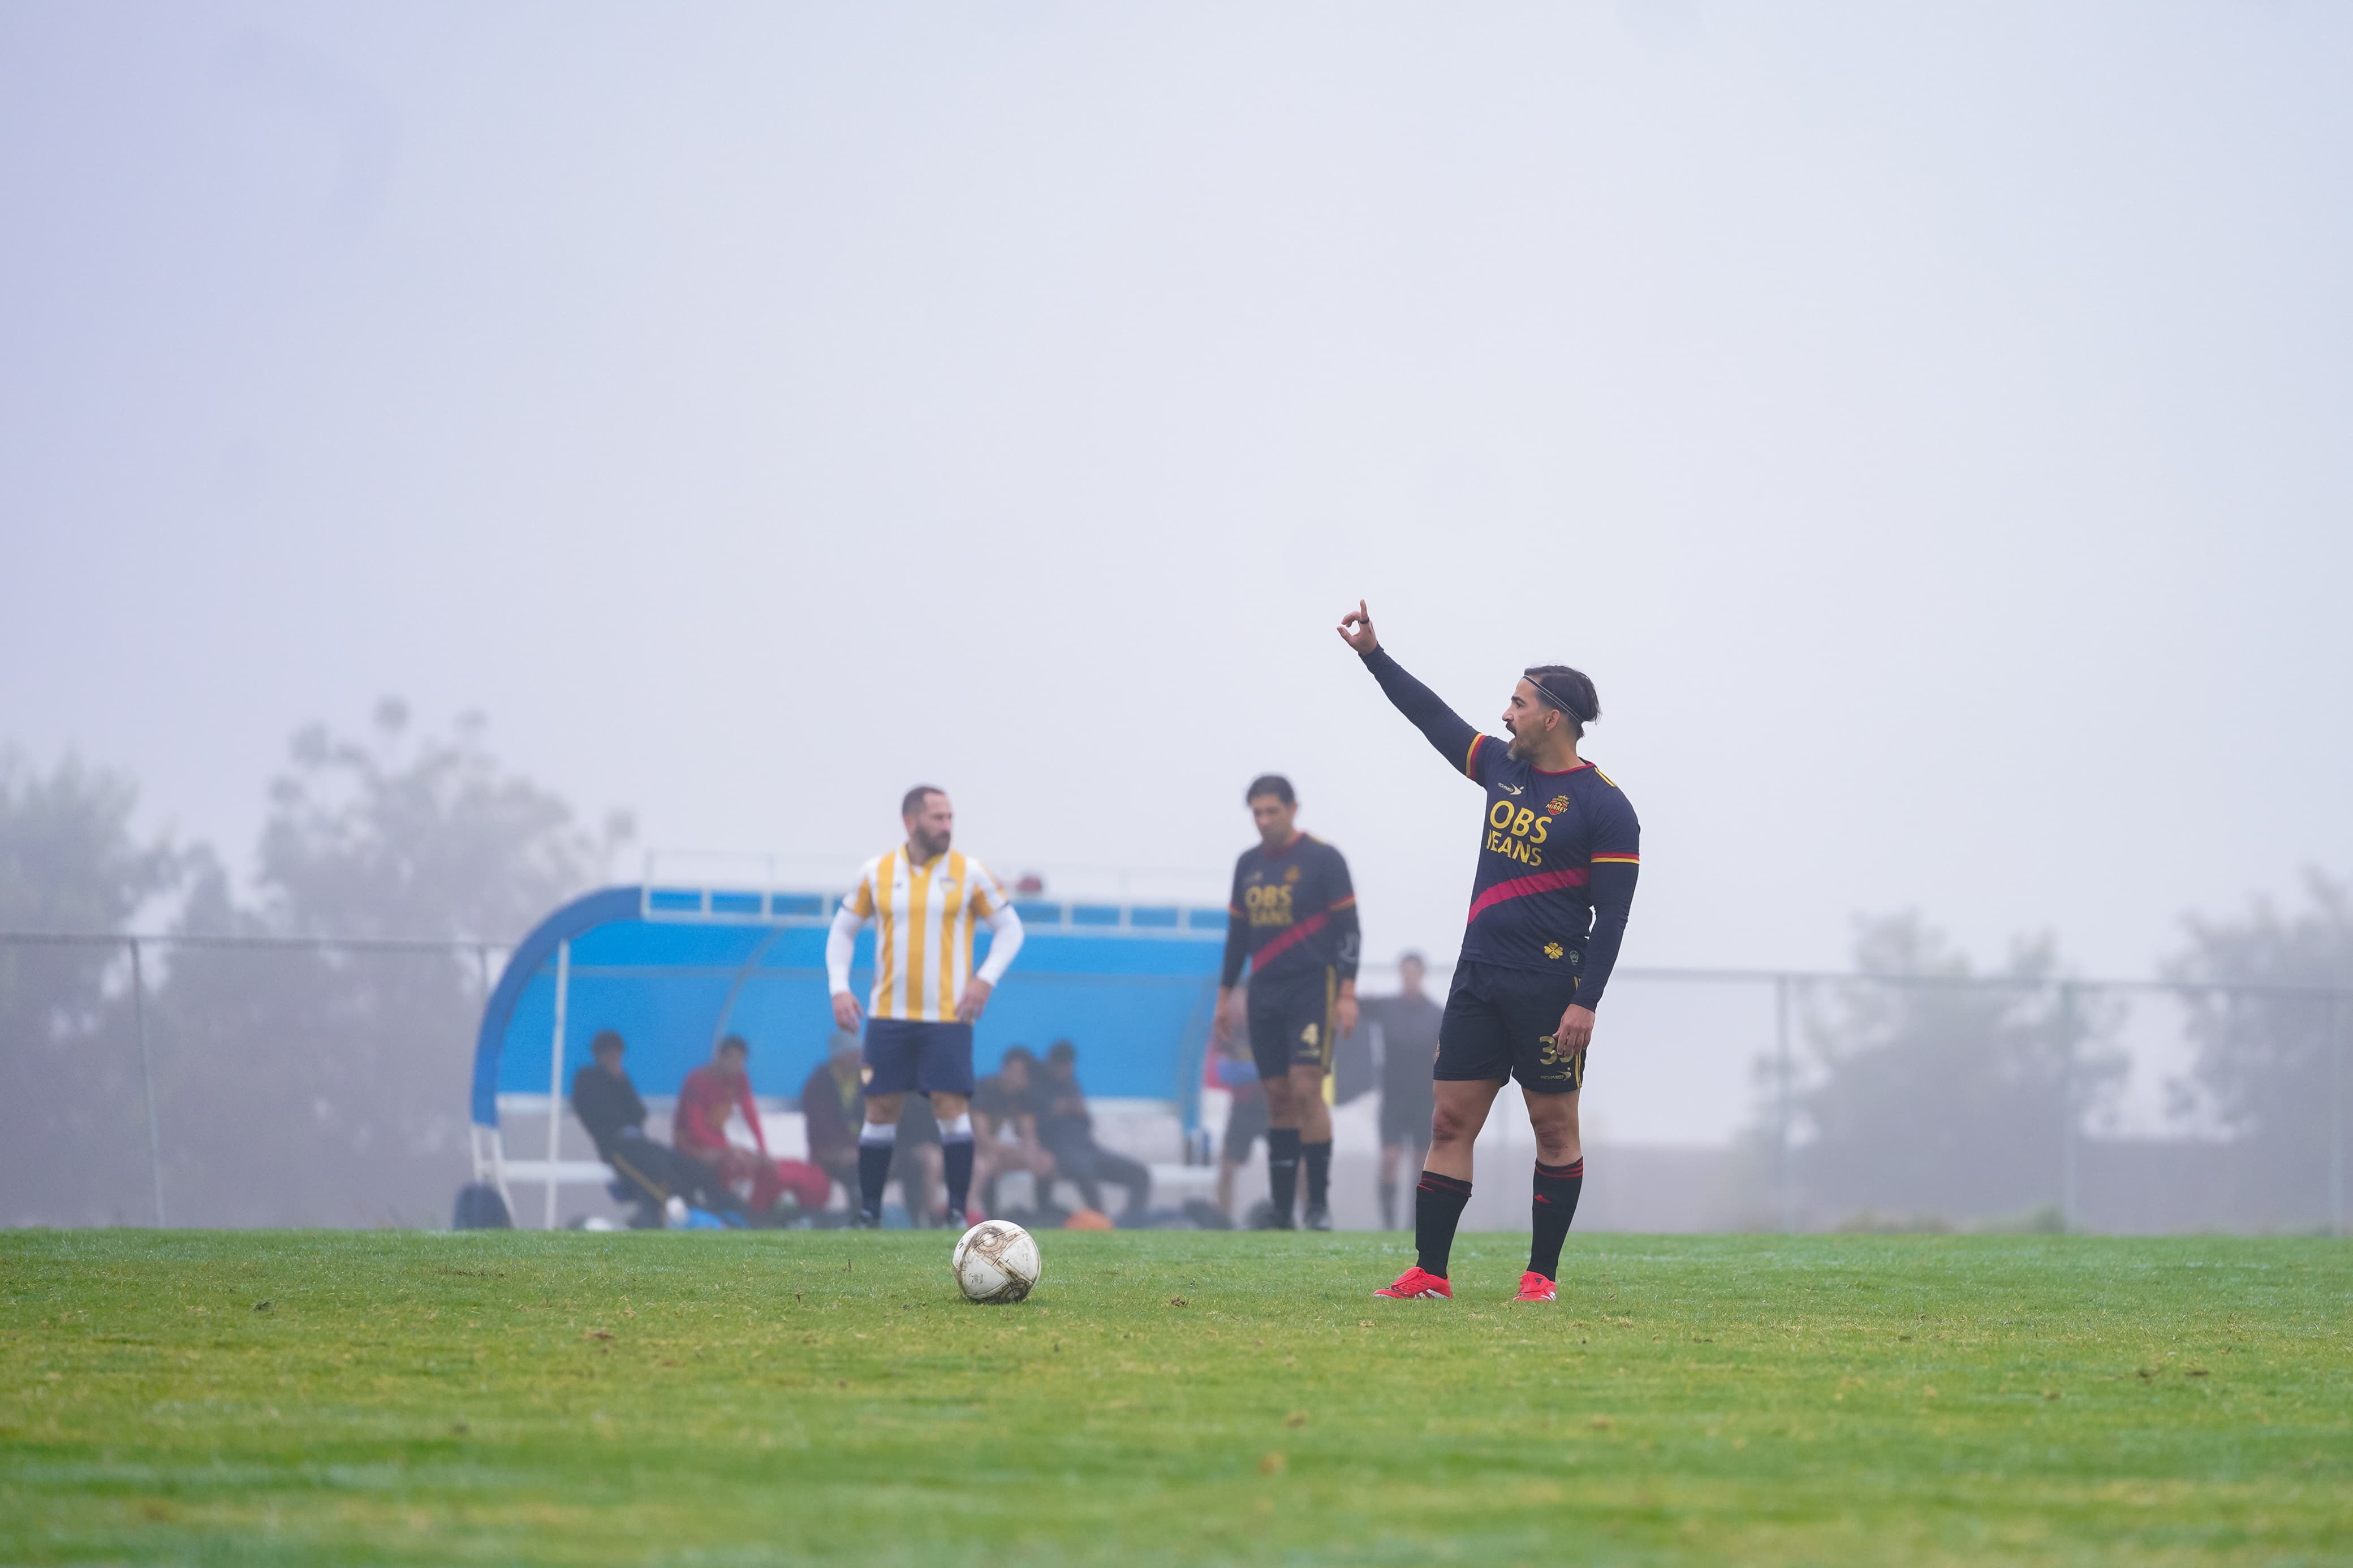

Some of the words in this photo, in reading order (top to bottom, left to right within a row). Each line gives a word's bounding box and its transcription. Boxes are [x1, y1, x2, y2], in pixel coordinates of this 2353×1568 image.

[1545, 803, 1568, 813] MIRREY
[1490, 800, 1552, 844] OBS
[1246, 885, 1292, 908] OBS
[1301, 1022, 1318, 1045] 4
